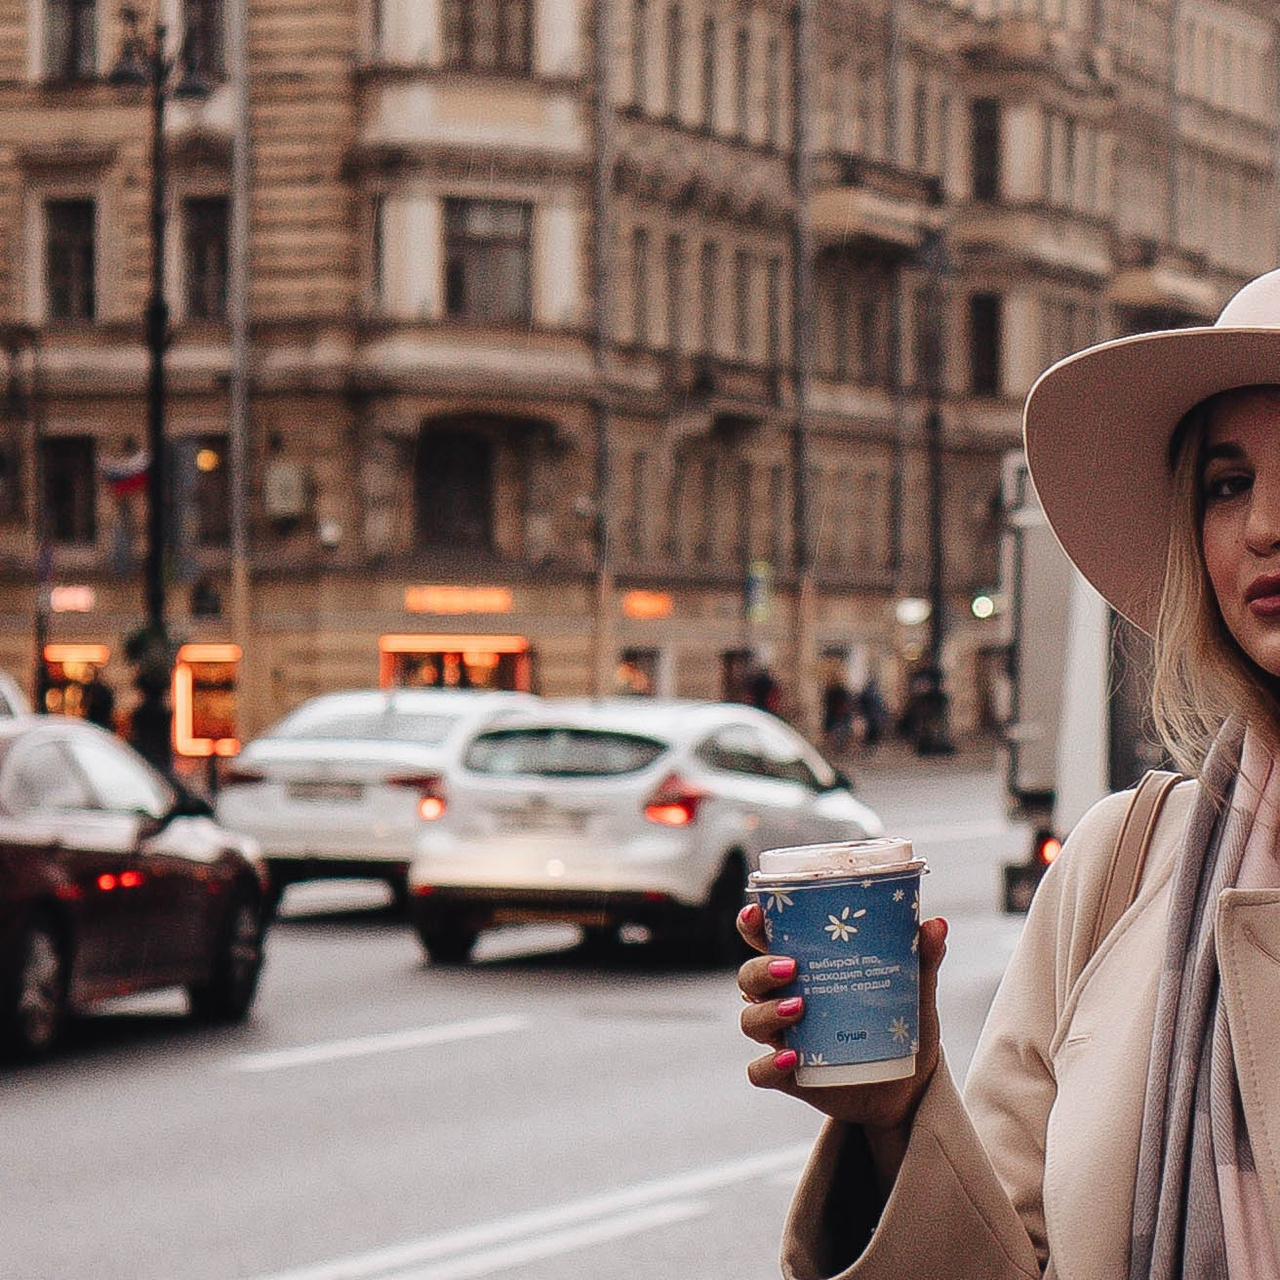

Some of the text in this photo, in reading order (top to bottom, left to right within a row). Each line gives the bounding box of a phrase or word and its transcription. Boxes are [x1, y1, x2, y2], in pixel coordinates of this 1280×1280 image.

[808, 955, 860, 970] выбирай
[813, 969, 863, 982] находит
[851, 979, 891, 992] сердце
[836, 1029, 868, 1043] буше
